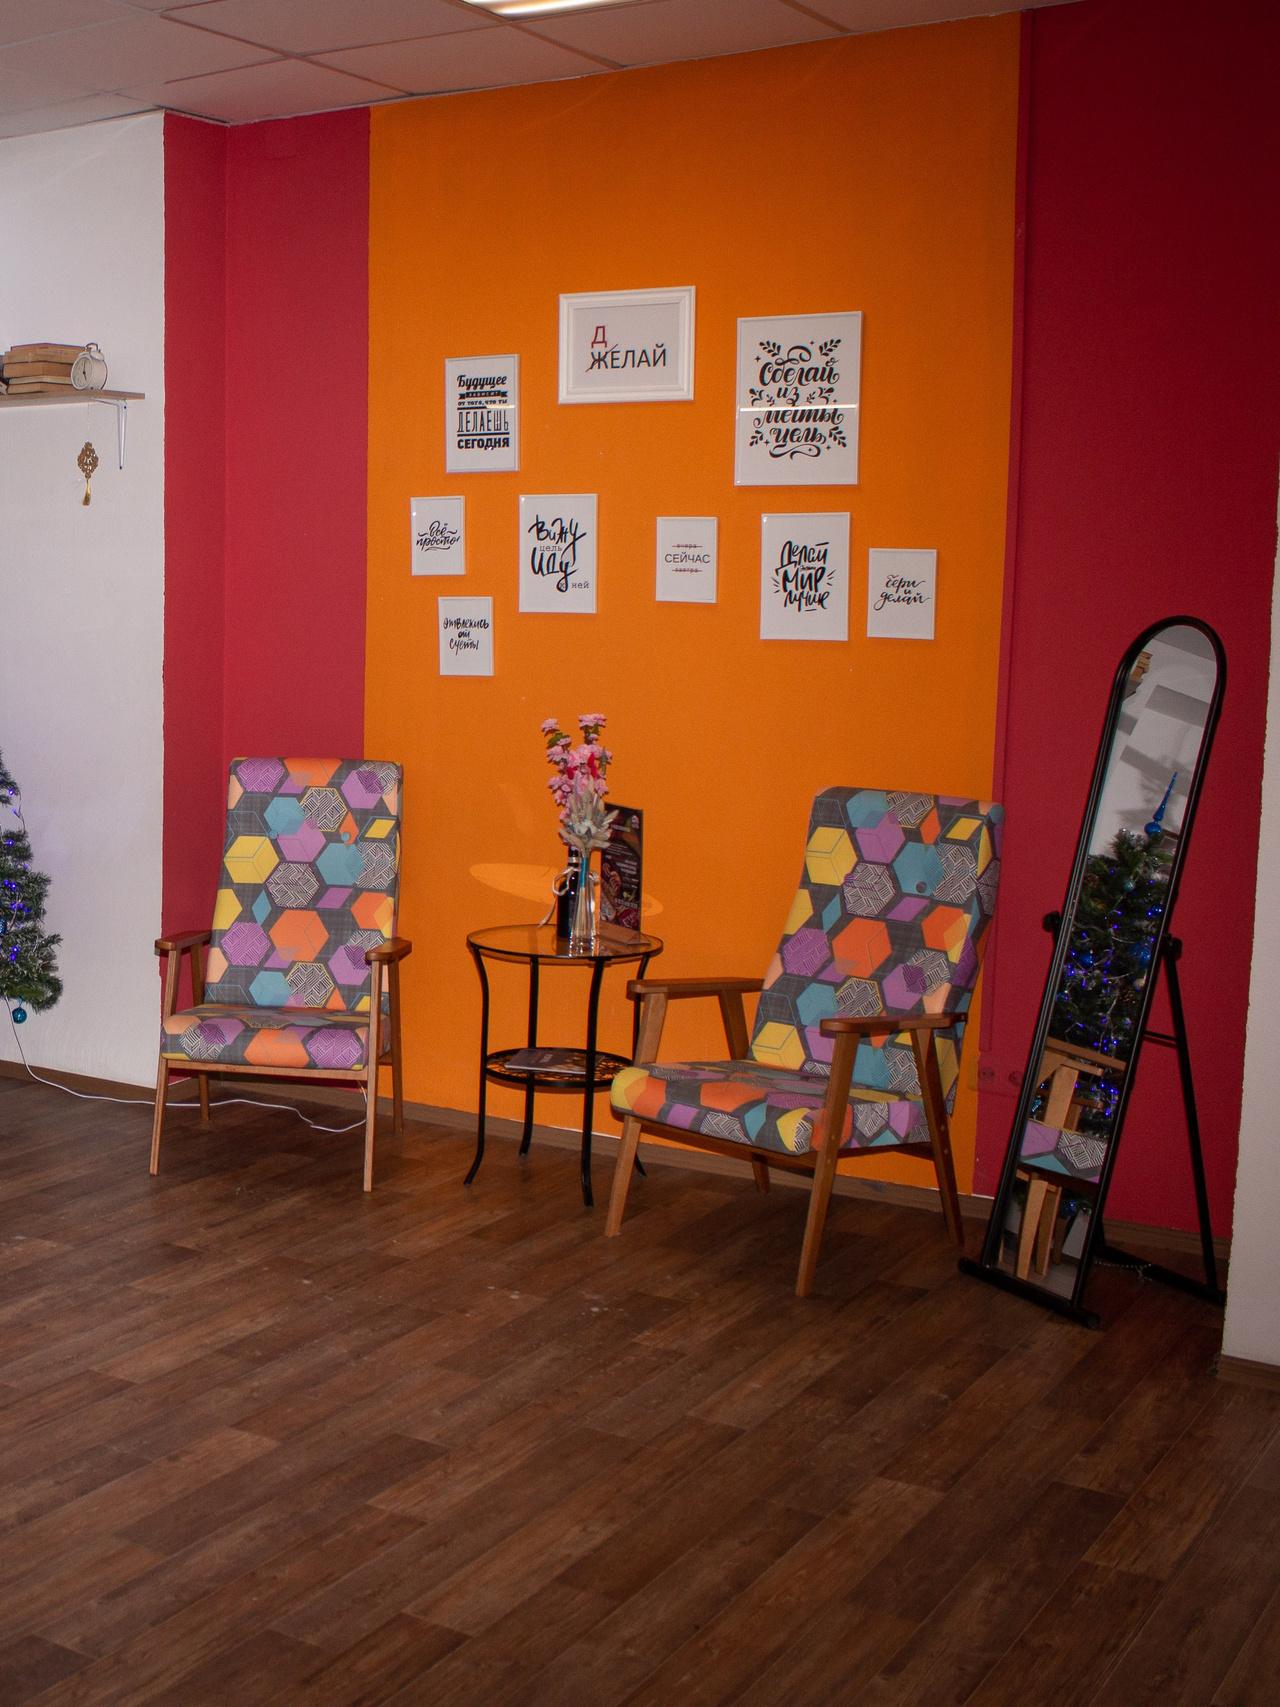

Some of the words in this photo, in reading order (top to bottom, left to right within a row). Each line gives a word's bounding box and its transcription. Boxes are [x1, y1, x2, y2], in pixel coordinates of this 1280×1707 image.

[589, 343, 668, 371] ЖЕЛАЙ
[456, 374, 508, 391] Будущее
[457, 410, 510, 433] ДЕЛАЕШЬ
[457, 437, 510, 450] СЕГОДНЯ
[664, 551, 711, 564] СЕЙЧАС
[571, 581, 590, 589] ней
